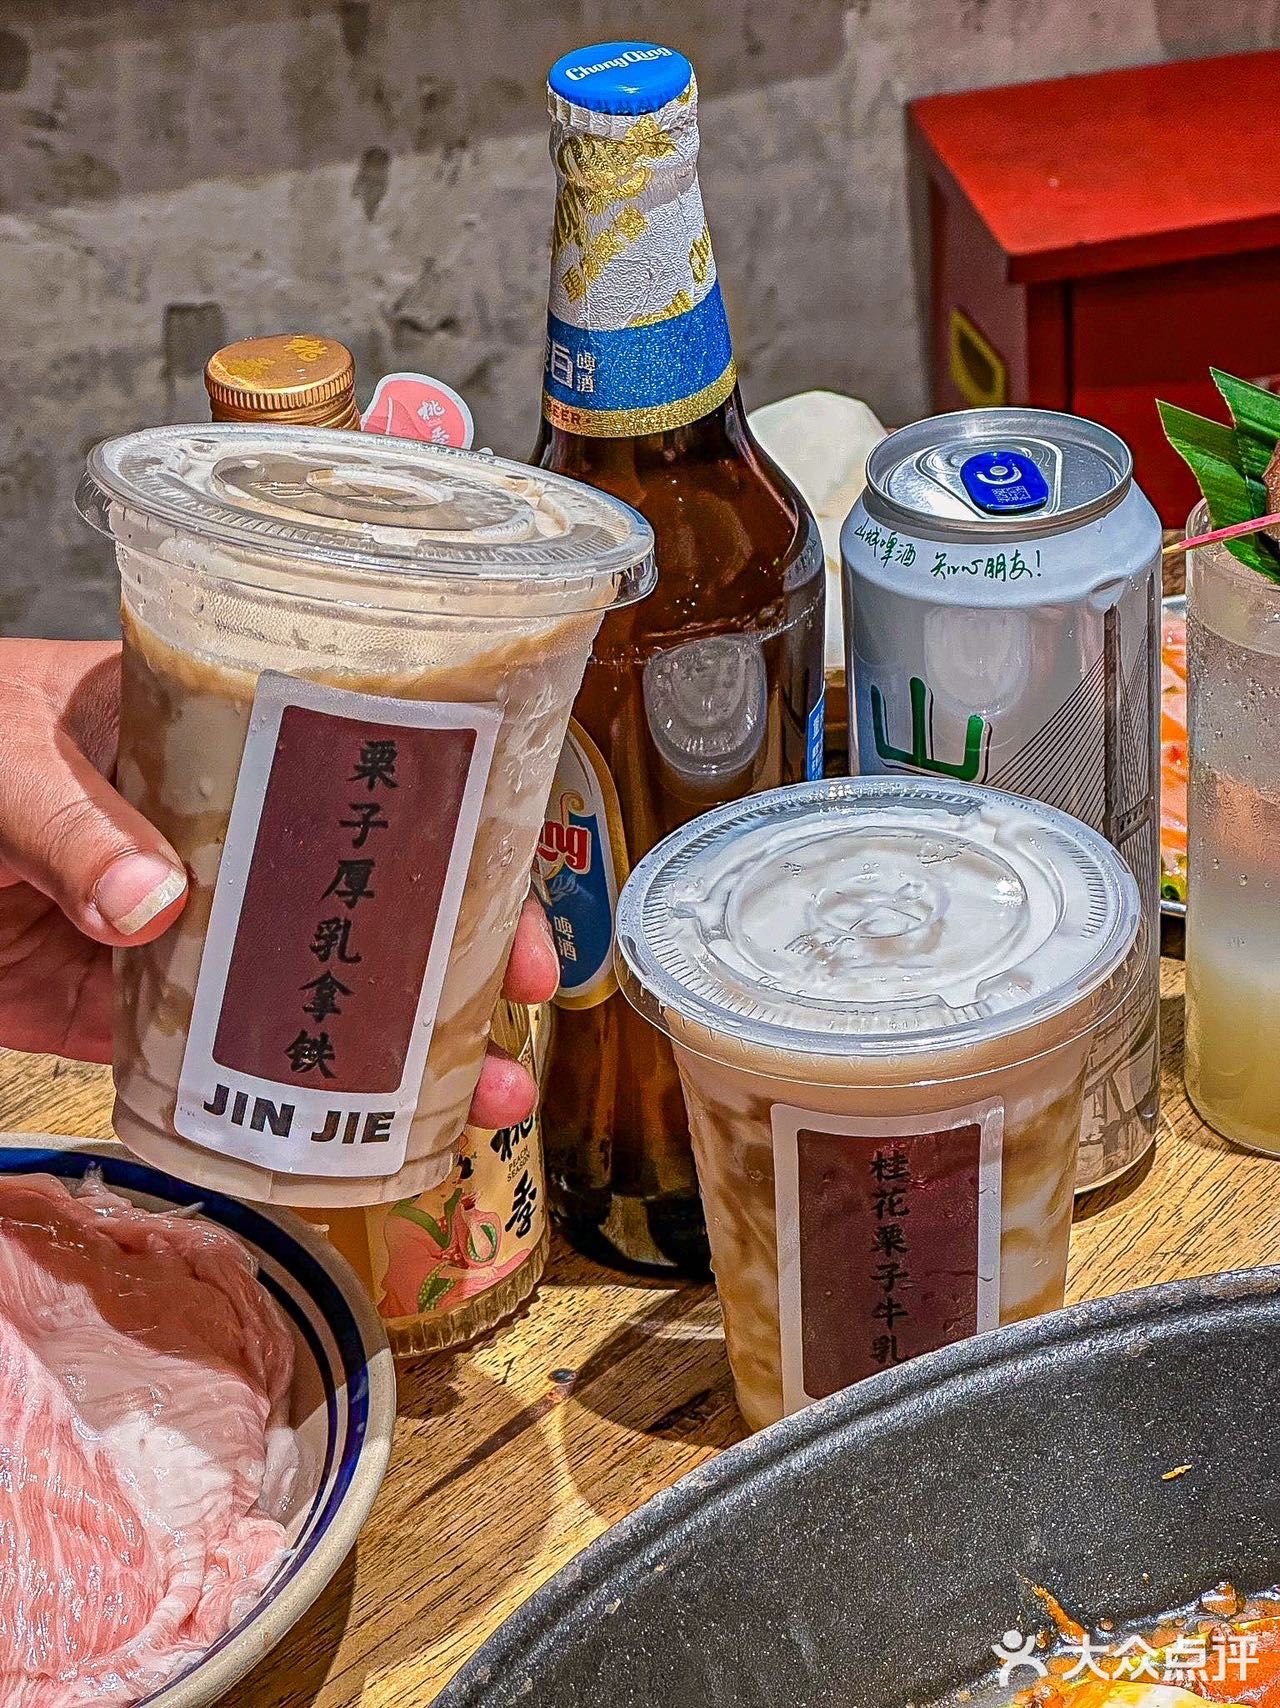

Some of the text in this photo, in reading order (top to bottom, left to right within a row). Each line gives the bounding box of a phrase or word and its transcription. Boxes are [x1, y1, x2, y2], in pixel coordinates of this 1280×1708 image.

[565, 47, 673, 81] ChongQing
[577, 349, 597, 393] 啤酒
[854, 517, 916, 568] 山城啤酒
[283, 740, 399, 1079] 栗子厚乳拿铁
[553, 916, 577, 961] 啤酒
[203, 1084, 396, 1144] JIN JIE
[870, 1150, 910, 1364] 桂花栗子牛乳
